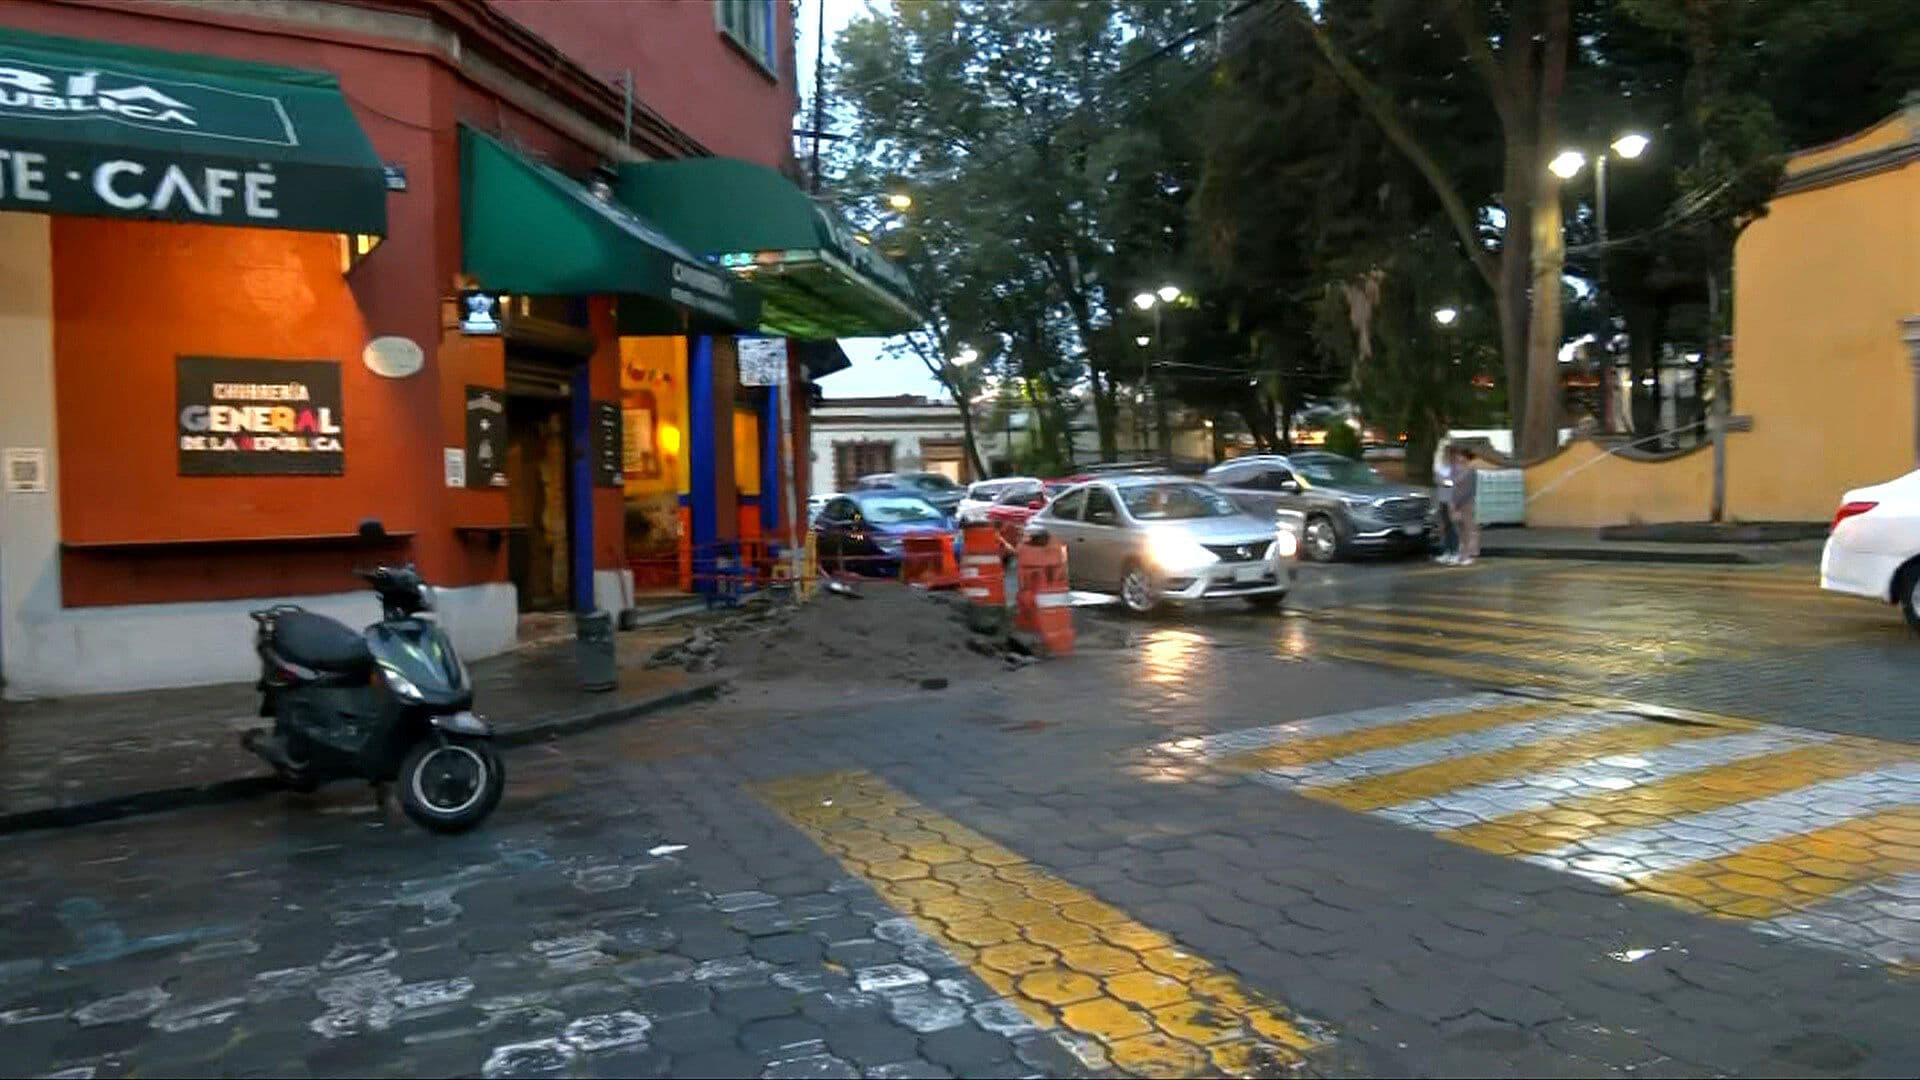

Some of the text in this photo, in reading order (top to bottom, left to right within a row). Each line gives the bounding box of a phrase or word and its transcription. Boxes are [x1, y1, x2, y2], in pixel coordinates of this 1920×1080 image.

[93, 159, 280, 219] CAFÉ
[180, 405, 341, 434] GENERAL
[180, 435, 205, 451] DE
[209, 435, 239, 452] LA
